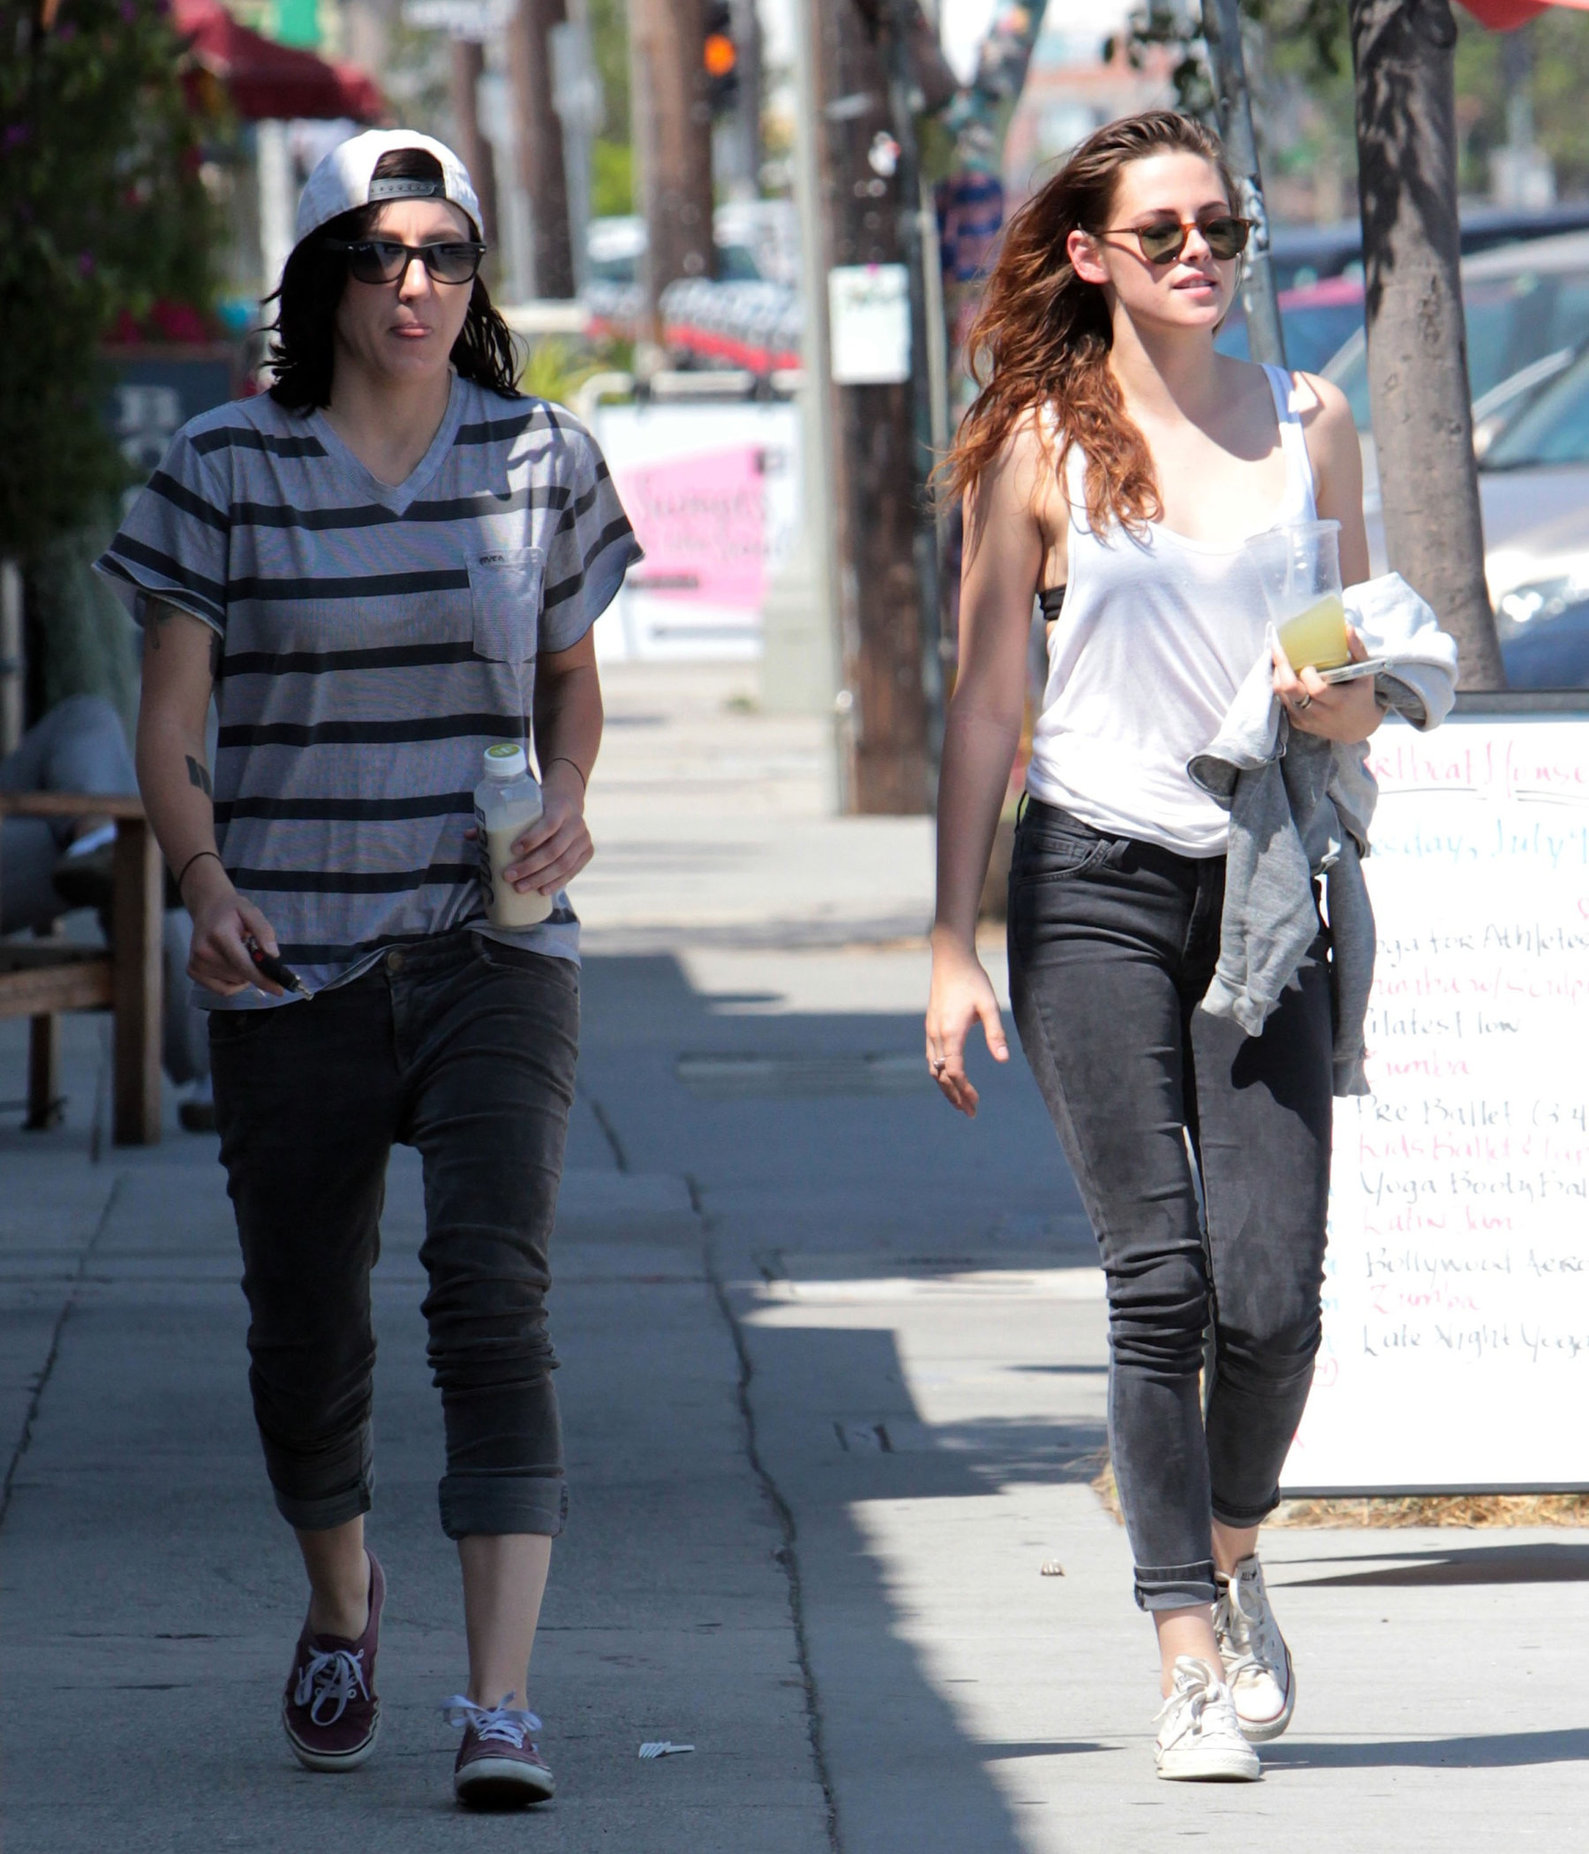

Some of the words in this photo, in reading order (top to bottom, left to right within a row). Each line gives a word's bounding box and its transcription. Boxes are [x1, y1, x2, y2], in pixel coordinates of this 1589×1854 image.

[1491, 817, 1565, 868] July
[1424, 1099, 1512, 1128] Ballet
[1360, 1170, 1438, 1207] Yoga
[1369, 1282, 1481, 1314] Zumba
[1362, 1323, 1422, 1357] Late
